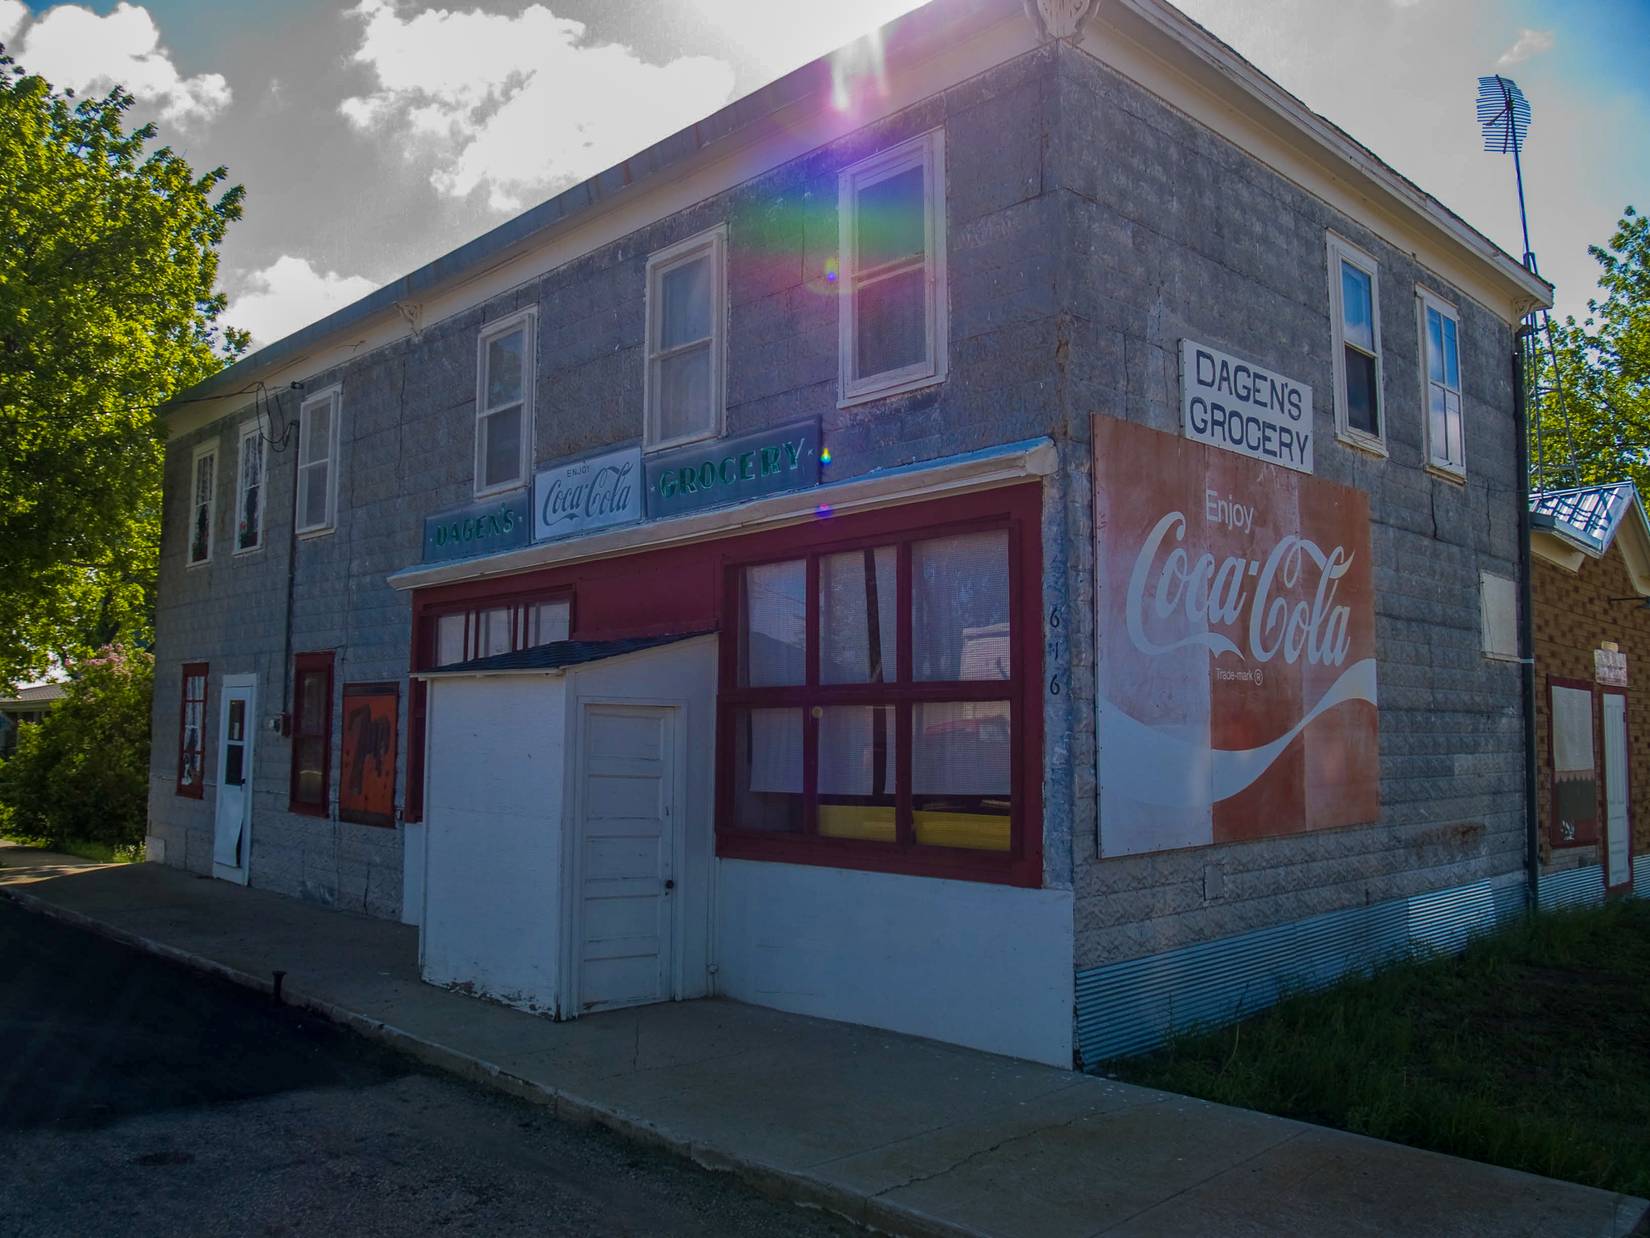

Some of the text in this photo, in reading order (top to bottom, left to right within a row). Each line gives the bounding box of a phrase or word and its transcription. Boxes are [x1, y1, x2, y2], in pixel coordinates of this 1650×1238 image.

[1195, 350, 1302, 421] DAGEN'S
[1190, 397, 1309, 465] GROCERY
[542, 461, 634, 527] Coca-Cola
[566, 464, 591, 478] ENJOY
[658, 438, 807, 498] GROCERY
[436, 502, 514, 546] DAGEN'S
[1206, 489, 1255, 534] Enjoy
[1126, 511, 1355, 667] Coca-Cola
